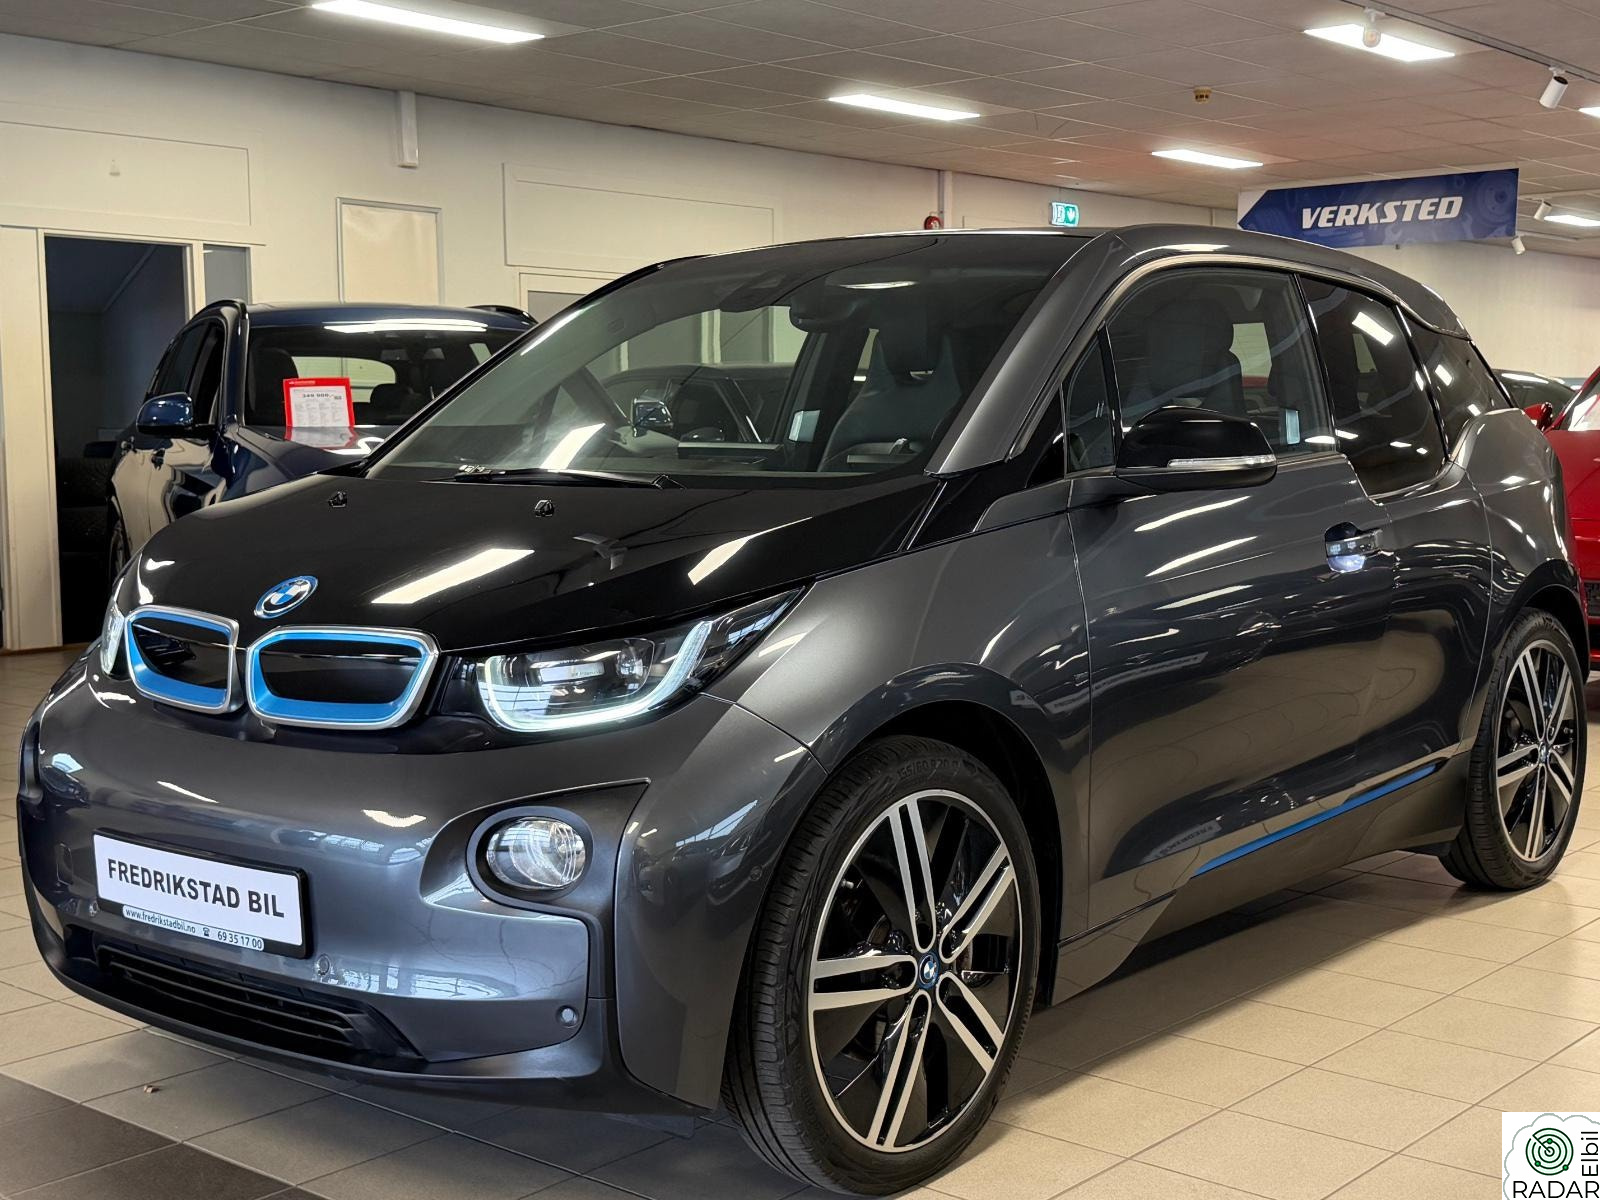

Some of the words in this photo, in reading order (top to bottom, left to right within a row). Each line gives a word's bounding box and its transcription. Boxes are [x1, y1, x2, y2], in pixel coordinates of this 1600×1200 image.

[1302, 196, 1463, 229] VERKSTED
[107, 858, 241, 909] FREDRIKSTAD
[247, 890, 285, 918] BIL
[125, 908, 196, 934] www.fredrikstadbil.no
[217, 930, 227, 941] 69
[228, 932, 239, 944] 35
[240, 935, 250, 946] 17
[251, 938, 263, 949] 00
